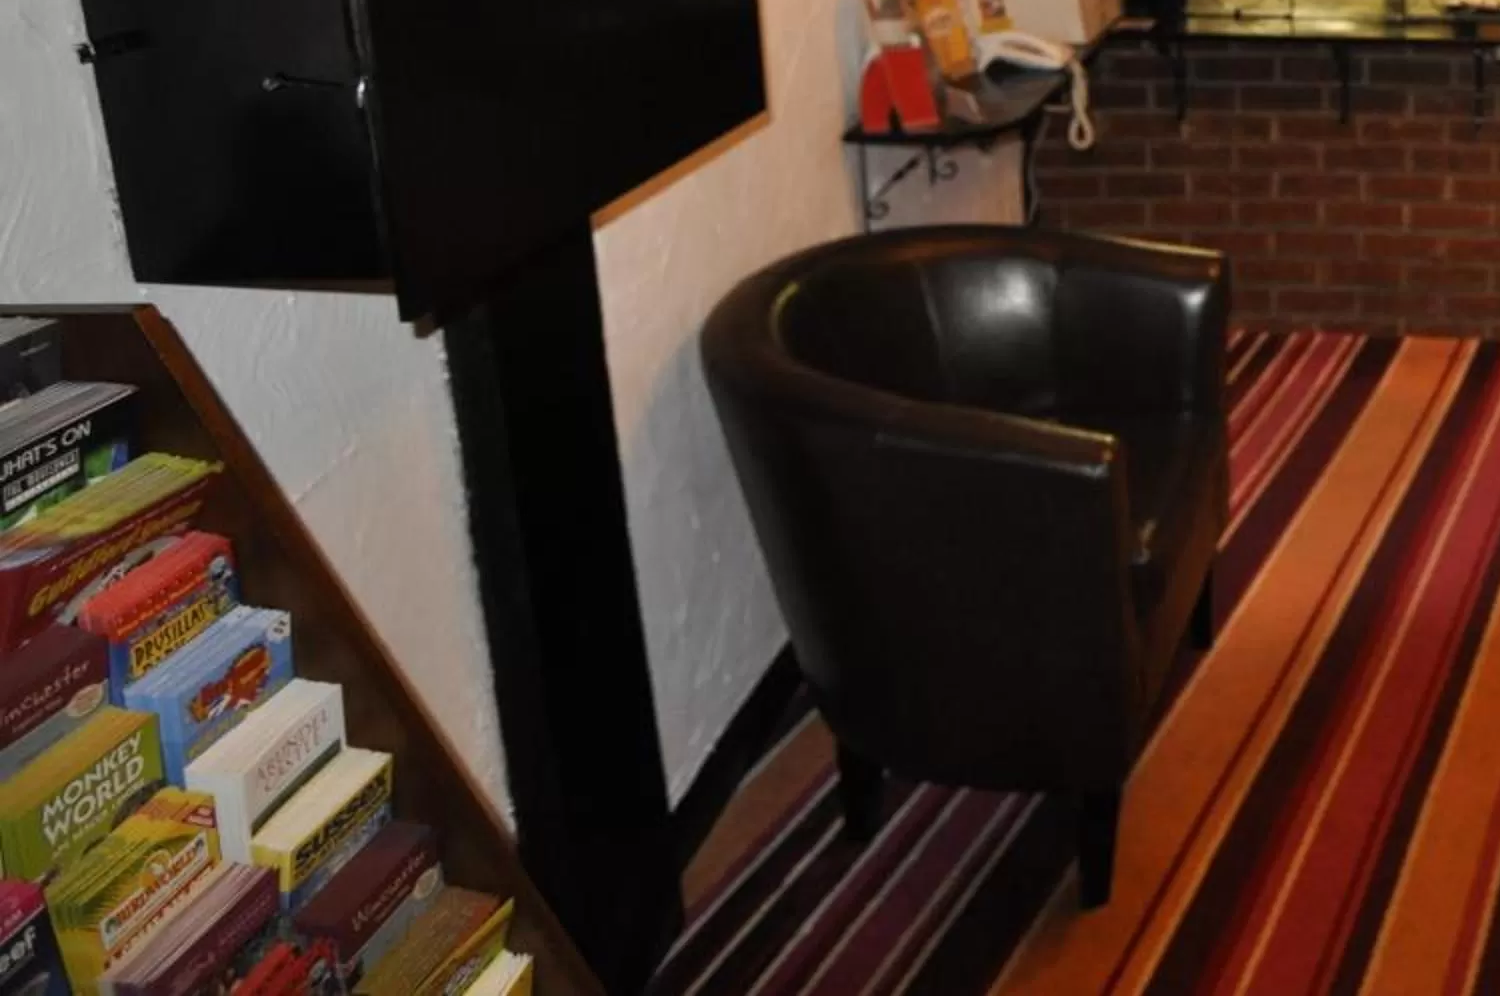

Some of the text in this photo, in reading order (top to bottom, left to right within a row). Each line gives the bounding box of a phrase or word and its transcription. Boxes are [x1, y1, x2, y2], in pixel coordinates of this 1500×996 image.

[61, 420, 92, 446] ON
[42, 731, 143, 824] MONKEY
[43, 756, 145, 845] WORLD
